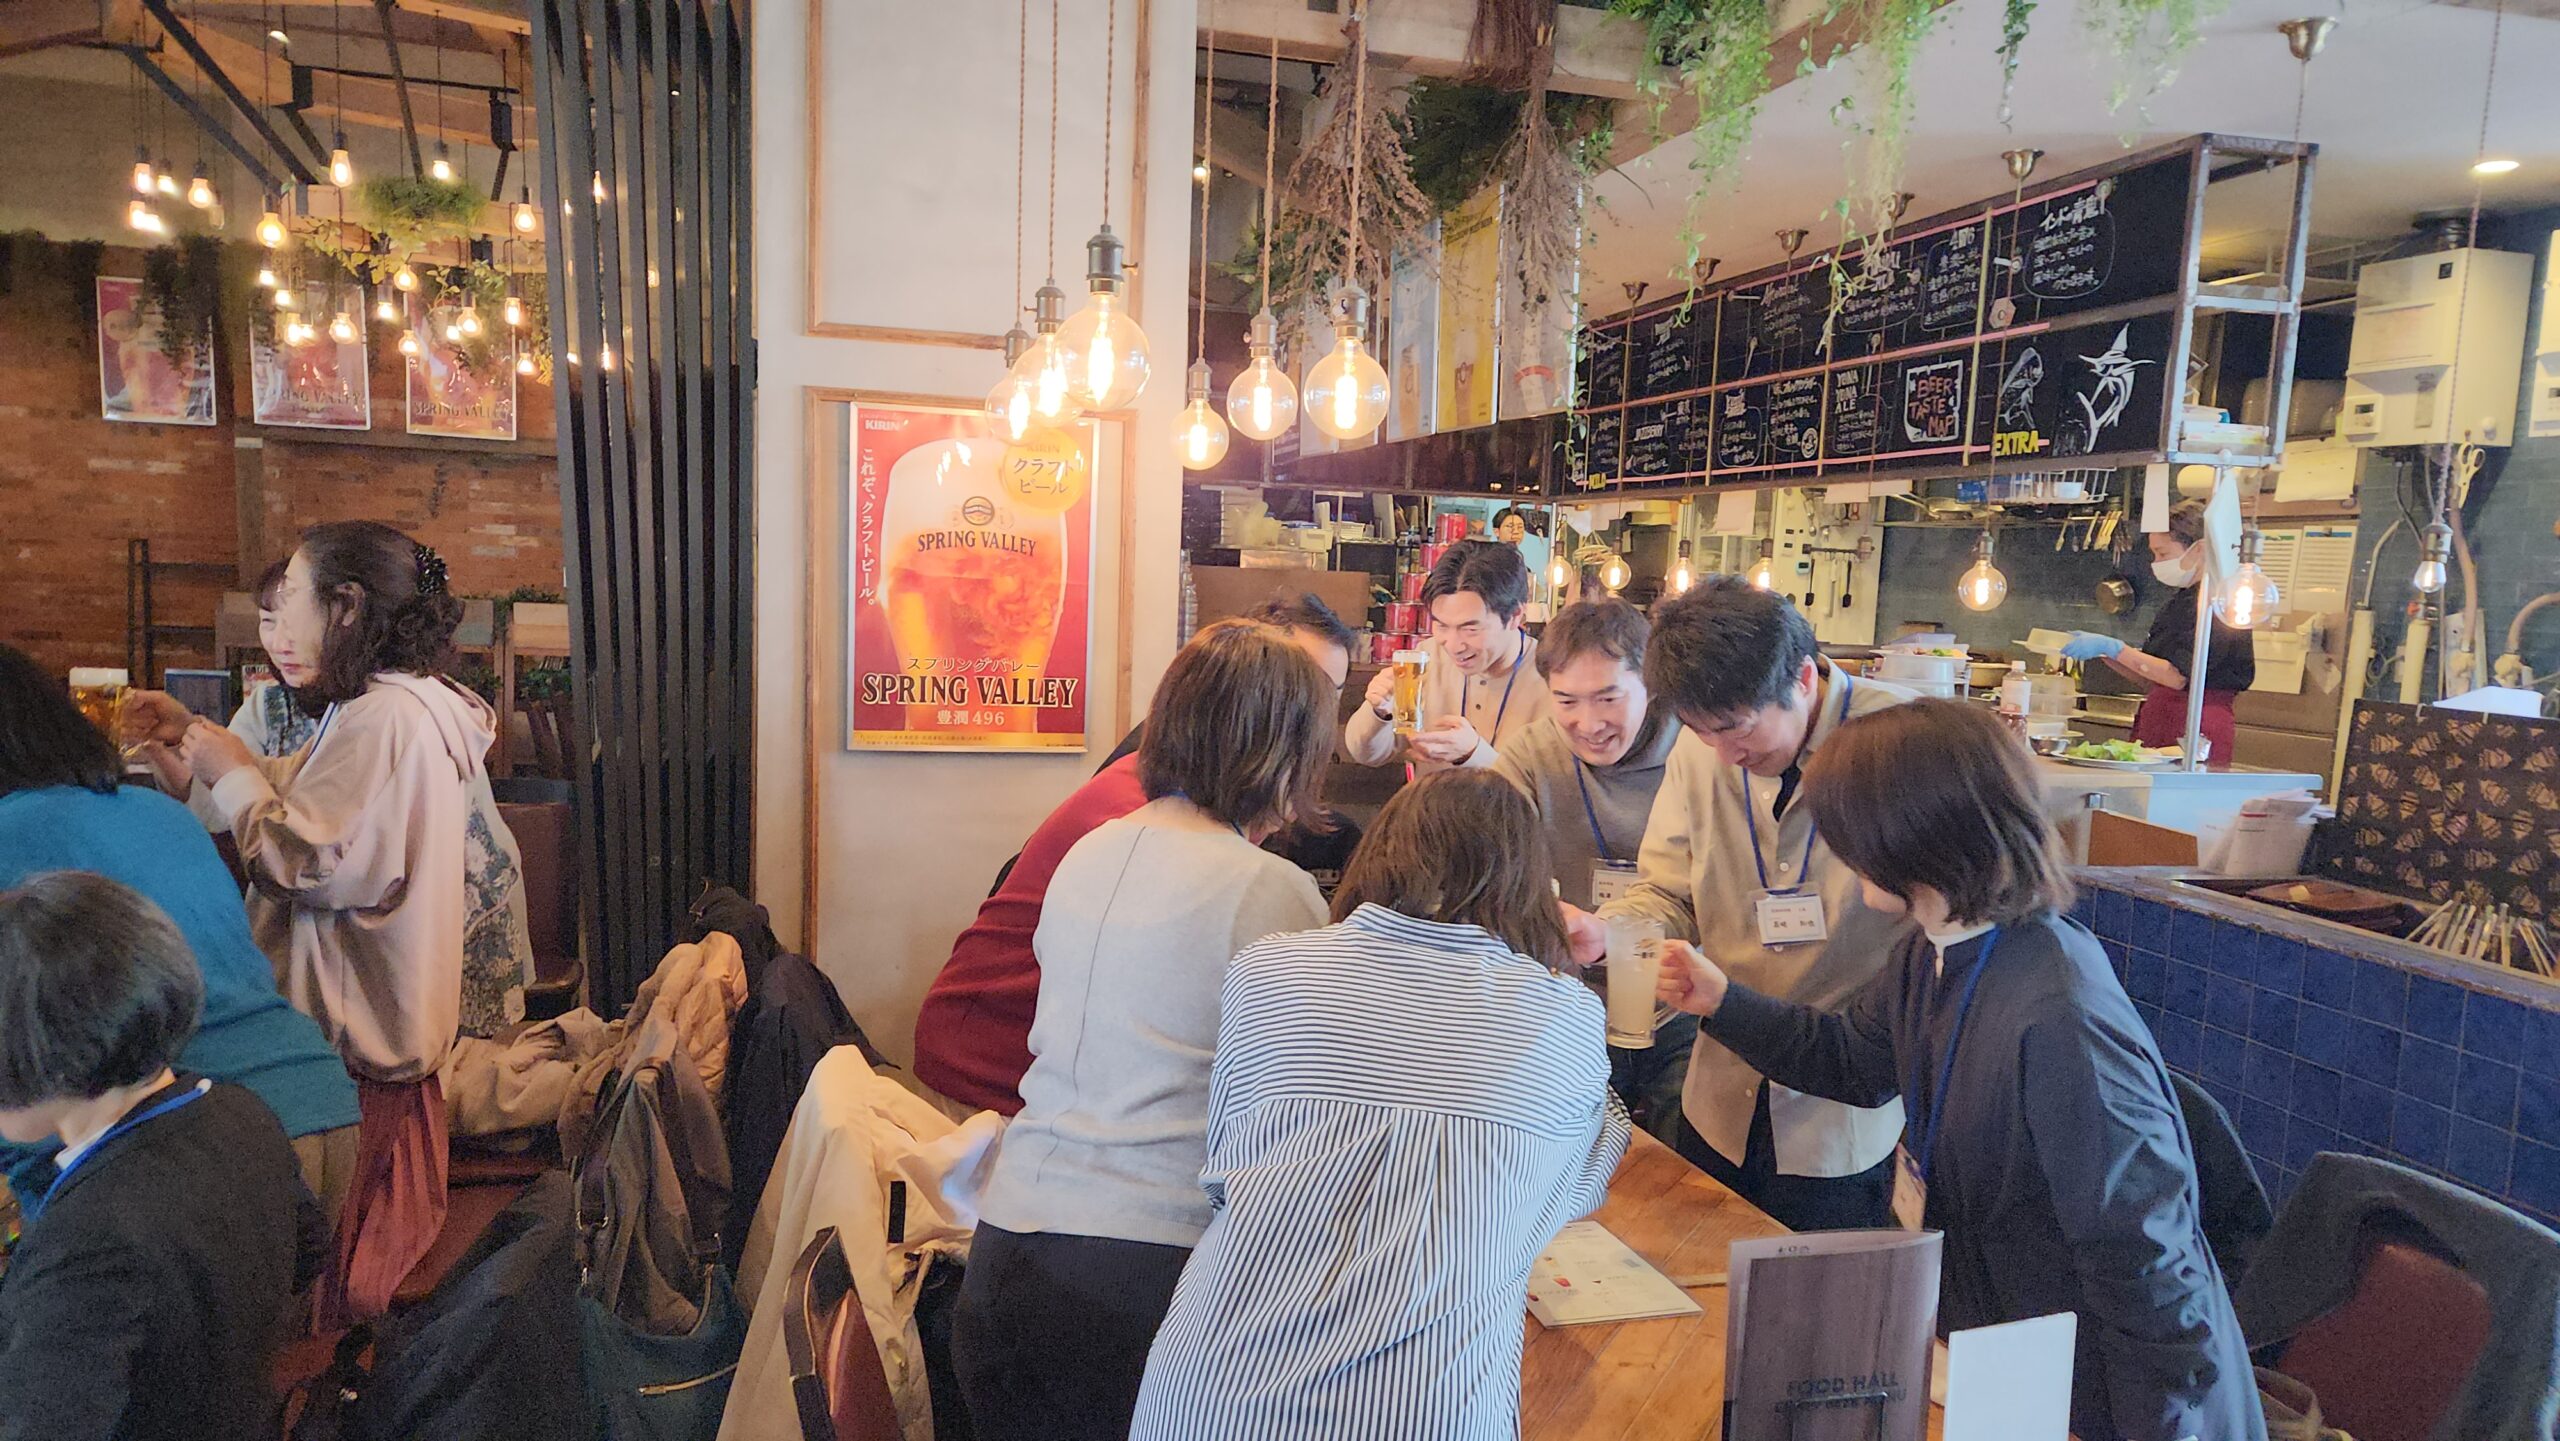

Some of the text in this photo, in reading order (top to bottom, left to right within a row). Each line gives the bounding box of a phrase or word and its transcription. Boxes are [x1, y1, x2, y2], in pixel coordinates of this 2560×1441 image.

[1917, 375, 1953, 398] BEER
[415, 402, 460, 418] SPRING
[1834, 398, 1857, 414] ALE
[1909, 395, 1946, 421] TASTE
[865, 420, 901, 431] KIRIN
[1927, 415, 1955, 437] MAP
[1994, 430, 2040, 456] EXTRA
[1013, 457, 1074, 477] クラフト
[1020, 478, 1068, 495] ビール
[859, 447, 878, 606] これぞ、クラフトビール。
[917, 531, 1037, 557] SPRING VALLEY
[907, 656, 1040, 672] スプリングバレー
[861, 673, 1079, 708] SPRING VALLEY
[936, 711, 1005, 726] 豊潤 496
[1787, 1371, 1898, 1395] FOOD HALL
